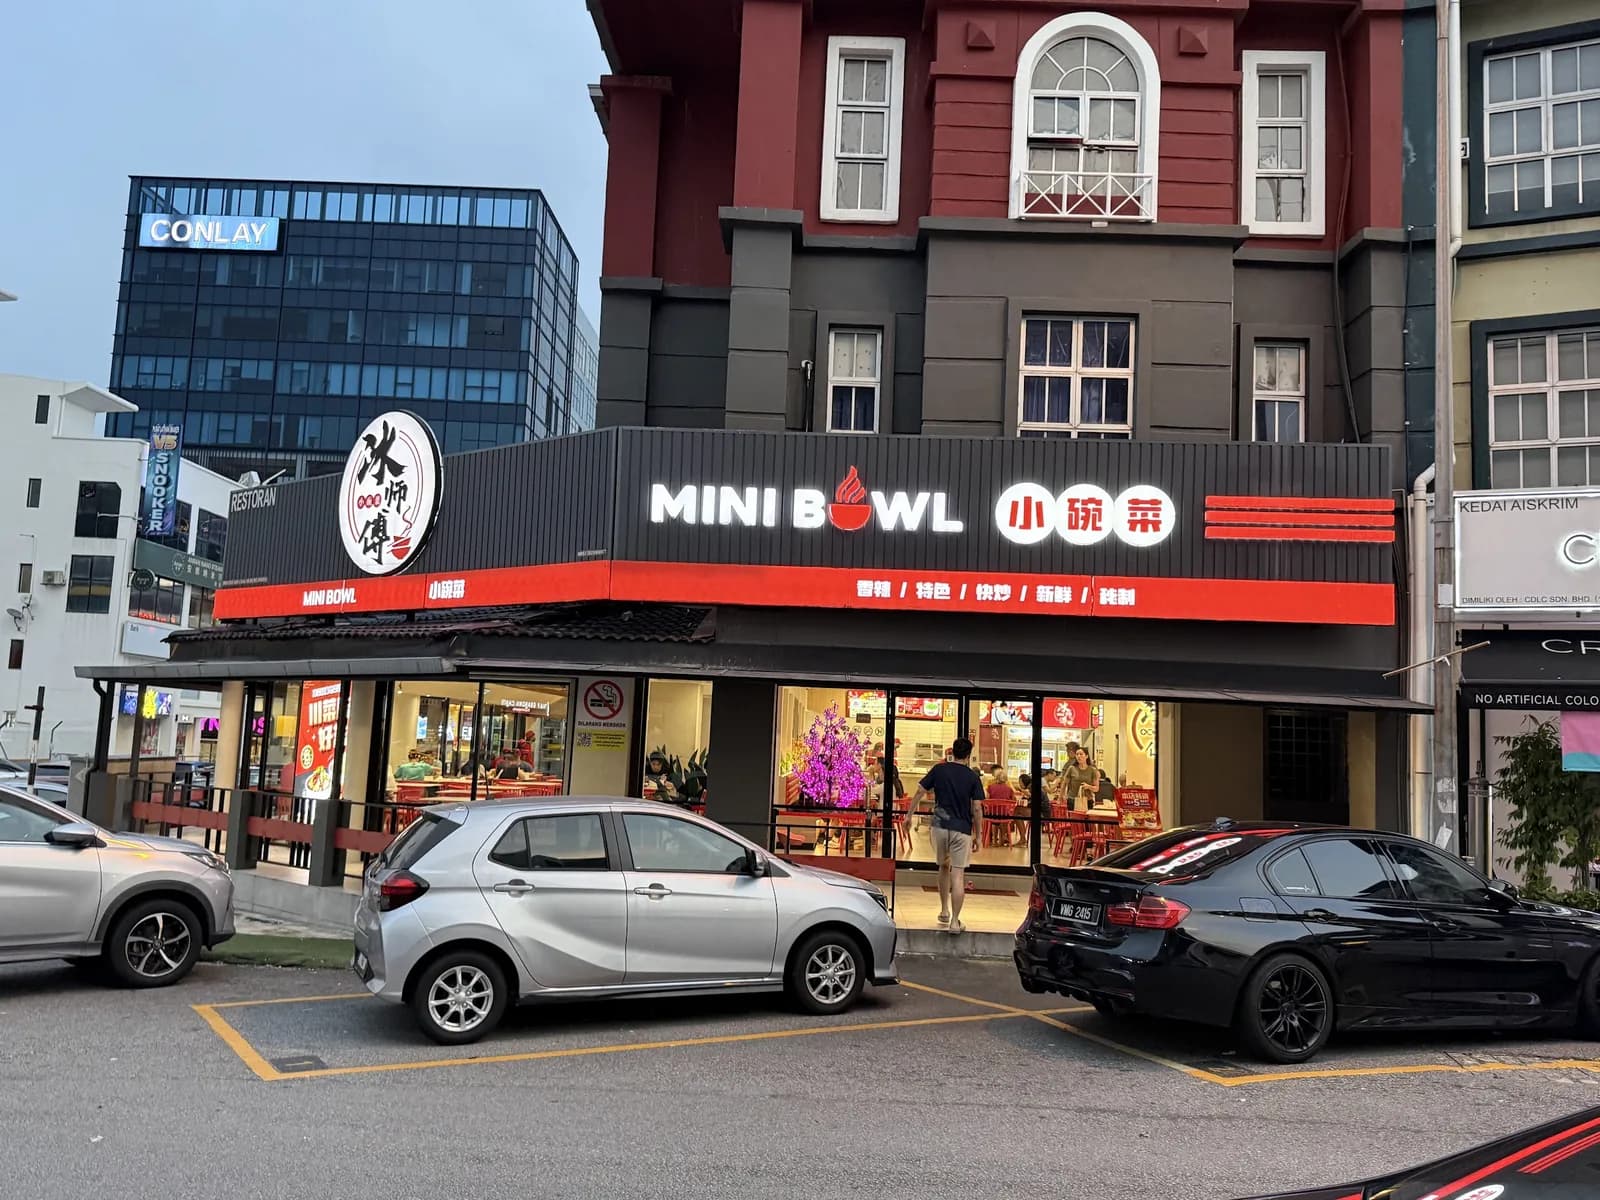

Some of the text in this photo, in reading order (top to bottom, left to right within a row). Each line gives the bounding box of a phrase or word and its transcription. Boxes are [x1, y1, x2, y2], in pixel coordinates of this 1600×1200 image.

[150, 219, 267, 246] CONLAY
[149, 453, 169, 531] SNOOKER
[231, 488, 277, 512] RESTORAN
[650, 484, 777, 527] MINI
[1009, 495, 1163, 533] 小碗菜
[1460, 497, 1578, 513] KEDAI AISKRIM
[303, 587, 357, 606] MINI BOWL
[429, 579, 466, 600] 小碗菜
[915, 582, 951, 600] 特色
[976, 583, 1011, 601] 快炒
[1035, 584, 1073, 603] 新鲜
[1462, 596, 1494, 604] DIMILIKI
[1496, 595, 1518, 604] OLEH
[1475, 694, 1494, 704] NO
[1496, 694, 1562, 706] ARTIFICIAL
[1074, 905, 1093, 920] 2415
